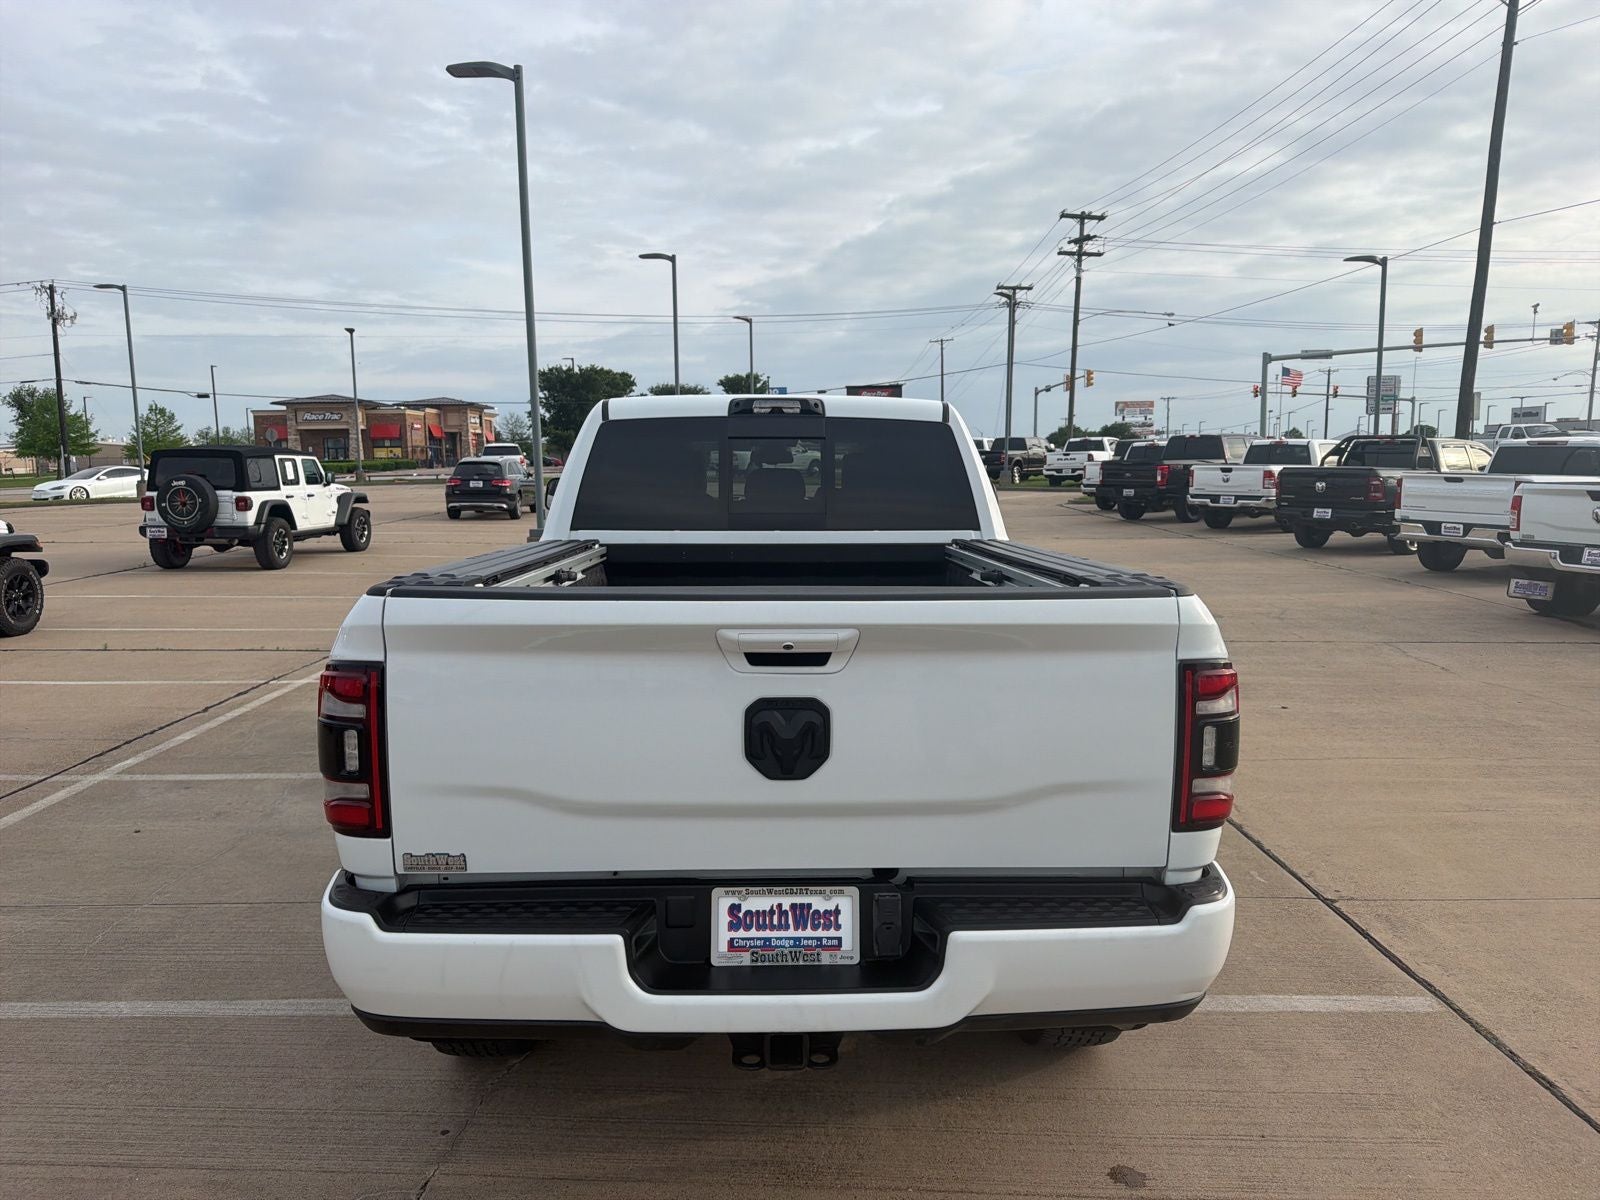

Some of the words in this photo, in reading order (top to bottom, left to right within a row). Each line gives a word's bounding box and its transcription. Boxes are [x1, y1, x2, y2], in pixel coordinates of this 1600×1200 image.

[303, 412, 342, 421] RaceTrac
[403, 853, 466, 865] SouthWest
[727, 902, 842, 932] SouthWest
[733, 938, 765, 948] Chrysler
[771, 938, 794, 947] Dodge
[800, 938, 817, 948] Jeep
[822, 938, 839, 947] Ram
[751, 950, 823, 964] SouthWest
